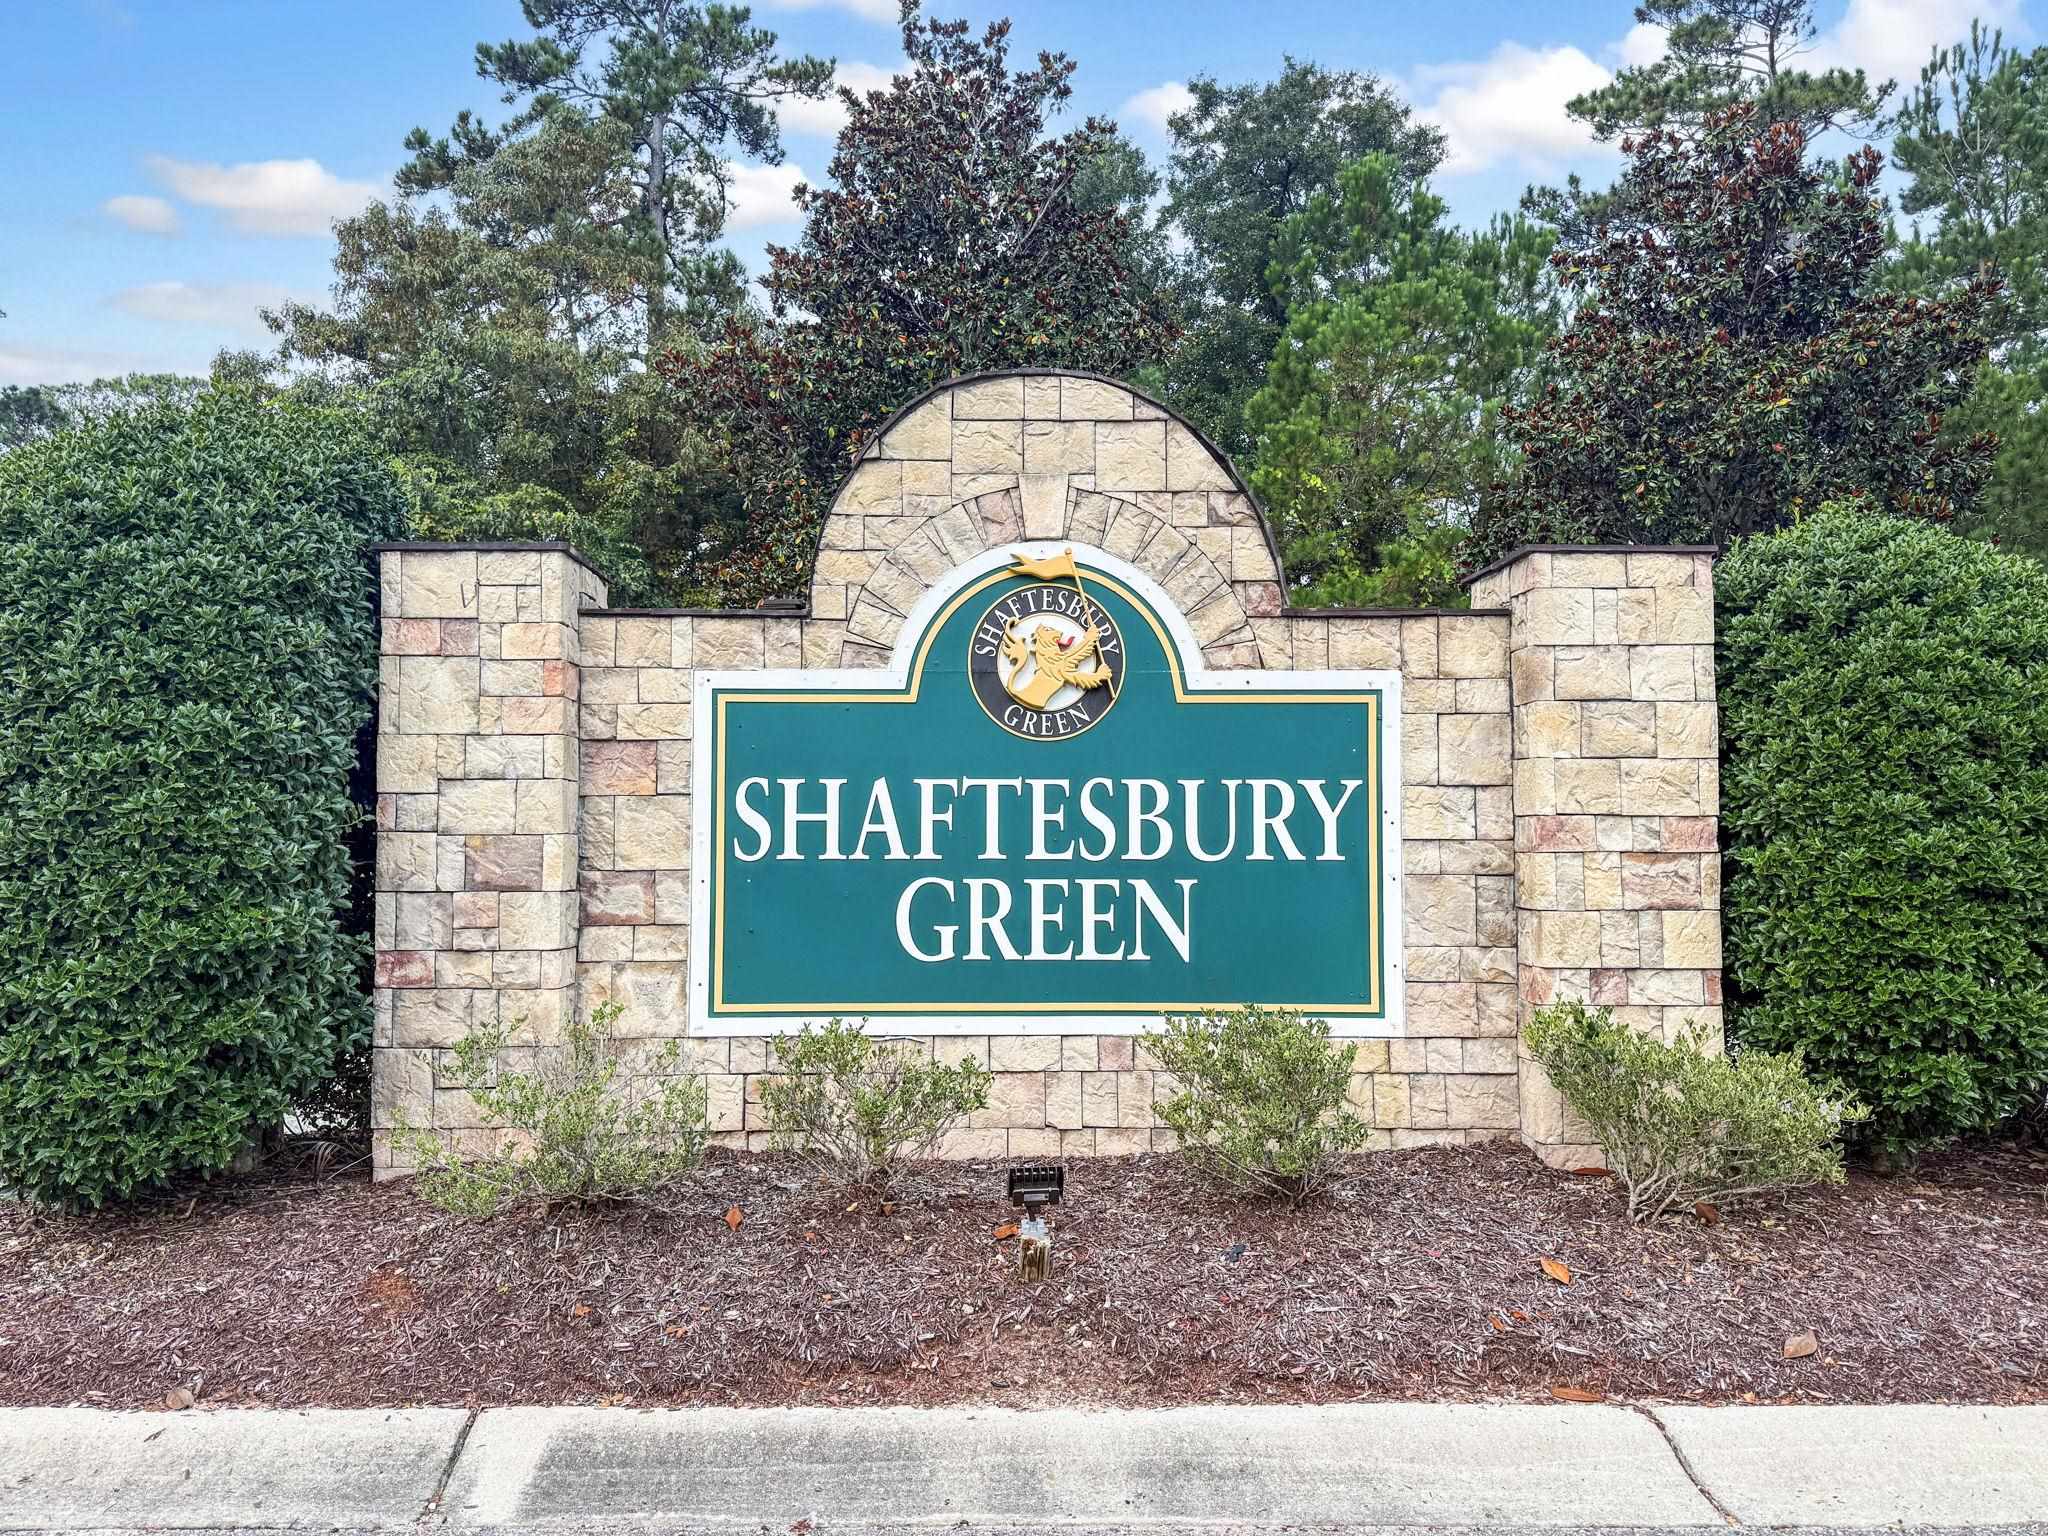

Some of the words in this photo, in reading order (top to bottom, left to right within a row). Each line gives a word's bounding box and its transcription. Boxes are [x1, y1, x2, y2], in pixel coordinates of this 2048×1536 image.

[1004, 702, 1091, 735] GREEN
[733, 776, 1363, 862] SHAFTESBURY
[896, 876, 1198, 963] GREEN
